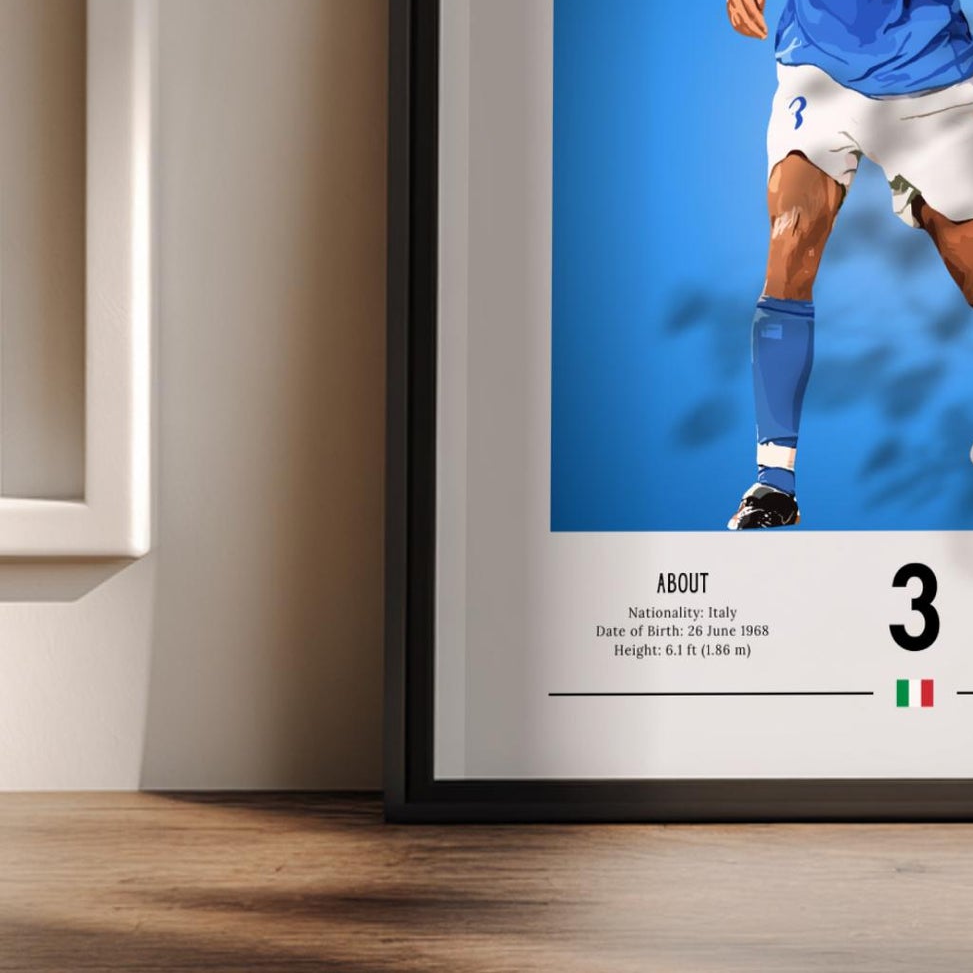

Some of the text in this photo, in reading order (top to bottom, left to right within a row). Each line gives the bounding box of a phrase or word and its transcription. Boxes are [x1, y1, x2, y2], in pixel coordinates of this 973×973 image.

[656, 572, 709, 594] ABOUT
[628, 605, 737, 622] Nationality: Italy
[889, 562, 940, 652] 3
[595, 624, 770, 638] Date of Birth: 26 June 1968
[614, 643, 752, 660] Height: 6.1 ft (1.86 m)
